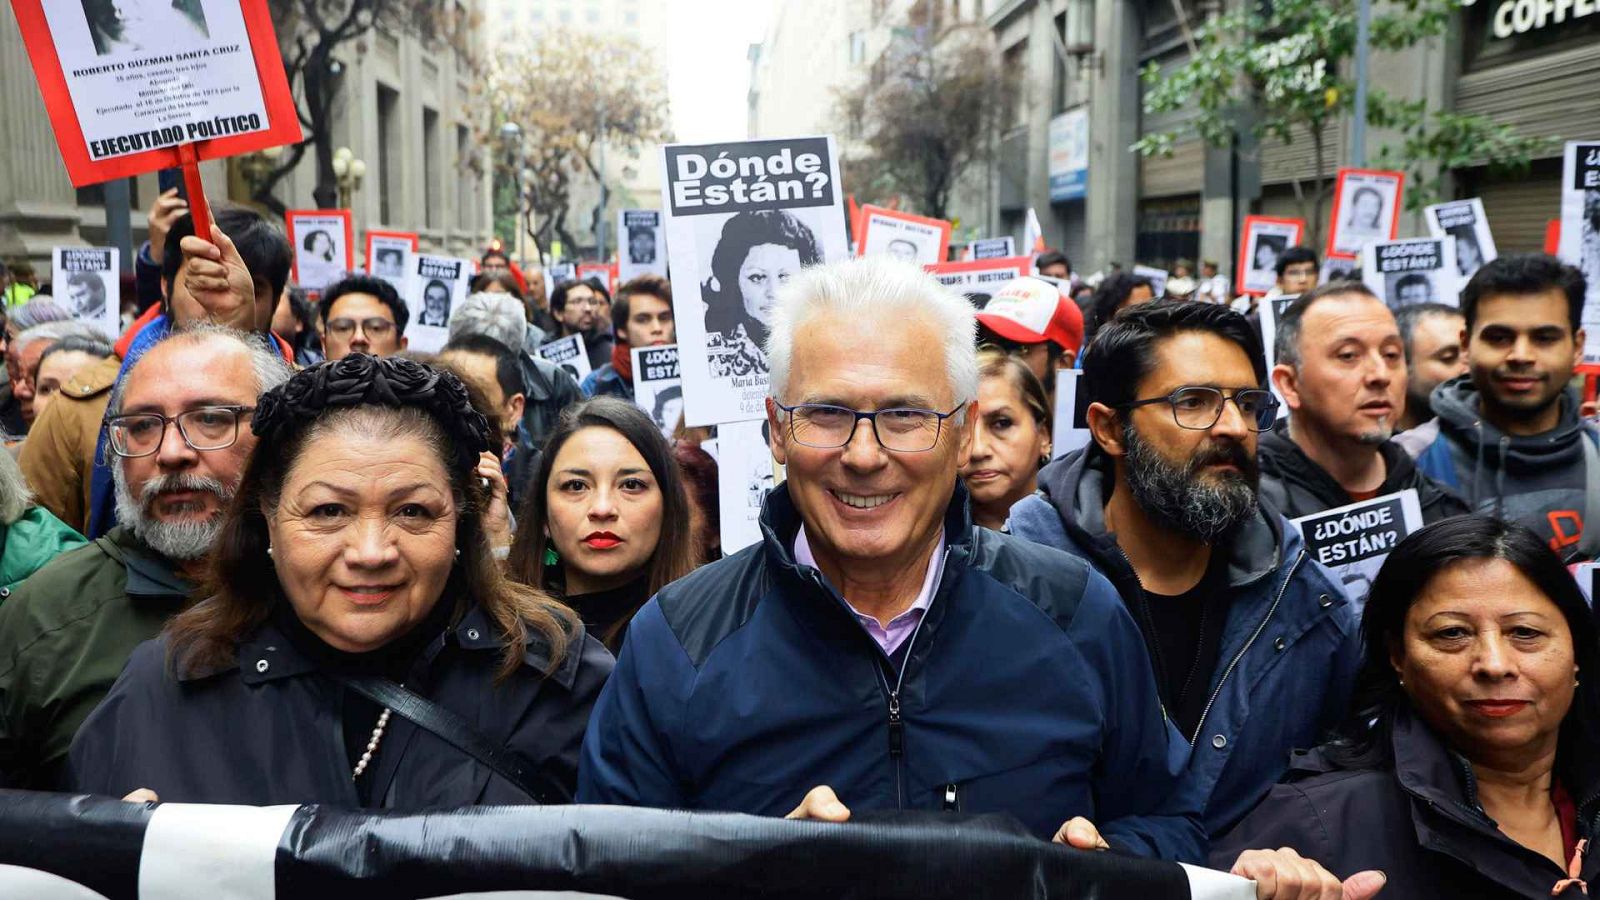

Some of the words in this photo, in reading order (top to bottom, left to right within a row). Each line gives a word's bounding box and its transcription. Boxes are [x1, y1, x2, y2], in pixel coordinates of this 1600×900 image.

[73, 63, 125, 78] ROBERTO
[128, 55, 173, 71] GUZMAN
[176, 50, 210, 62] SANTA
[212, 45, 241, 56] CRUZ
[90, 125, 184, 160] EJECUTADO
[186, 113, 261, 140] POLÍTICO
[676, 148, 822, 181] Dónde
[673, 172, 830, 208] Están?
[978, 271, 1015, 283] JUSTICIA
[1314, 506, 1394, 541] ¿DÓNDE
[1318, 530, 1398, 564] ESTÁN?
